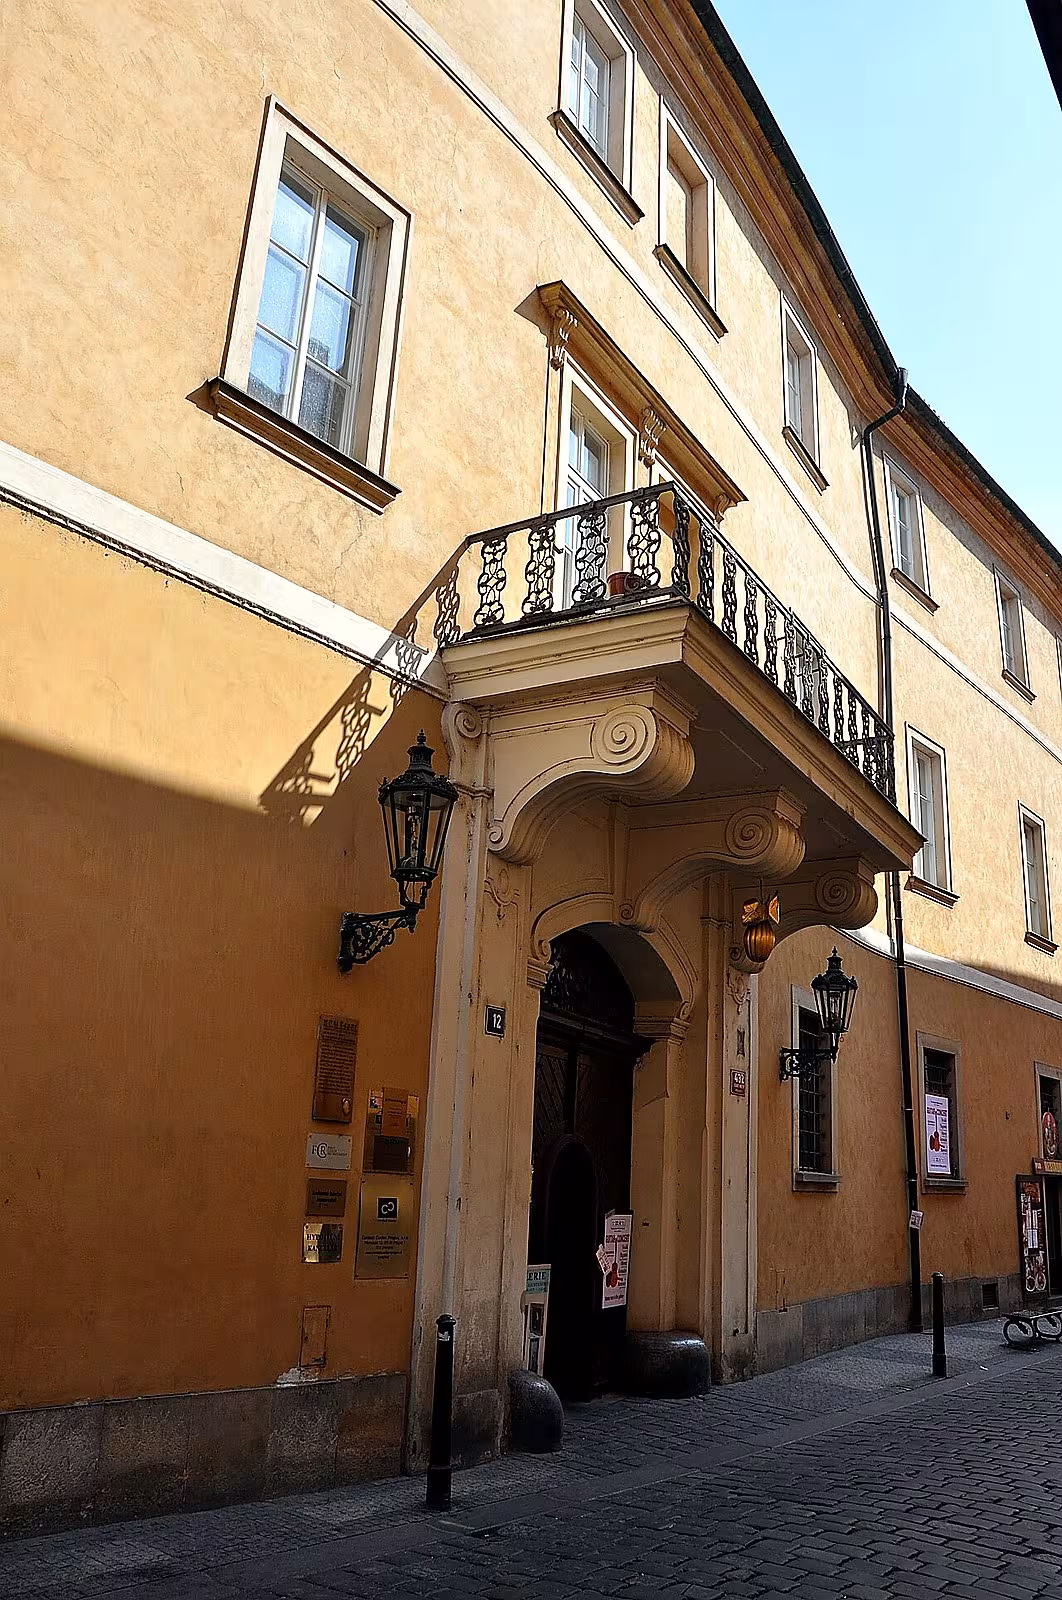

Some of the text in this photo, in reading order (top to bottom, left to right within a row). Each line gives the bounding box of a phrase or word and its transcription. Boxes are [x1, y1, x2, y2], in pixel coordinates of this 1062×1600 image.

[493, 1013, 502, 1029] 12
[734, 1073, 745, 1085] 432
[527, 1271, 548, 1281] ERIE
